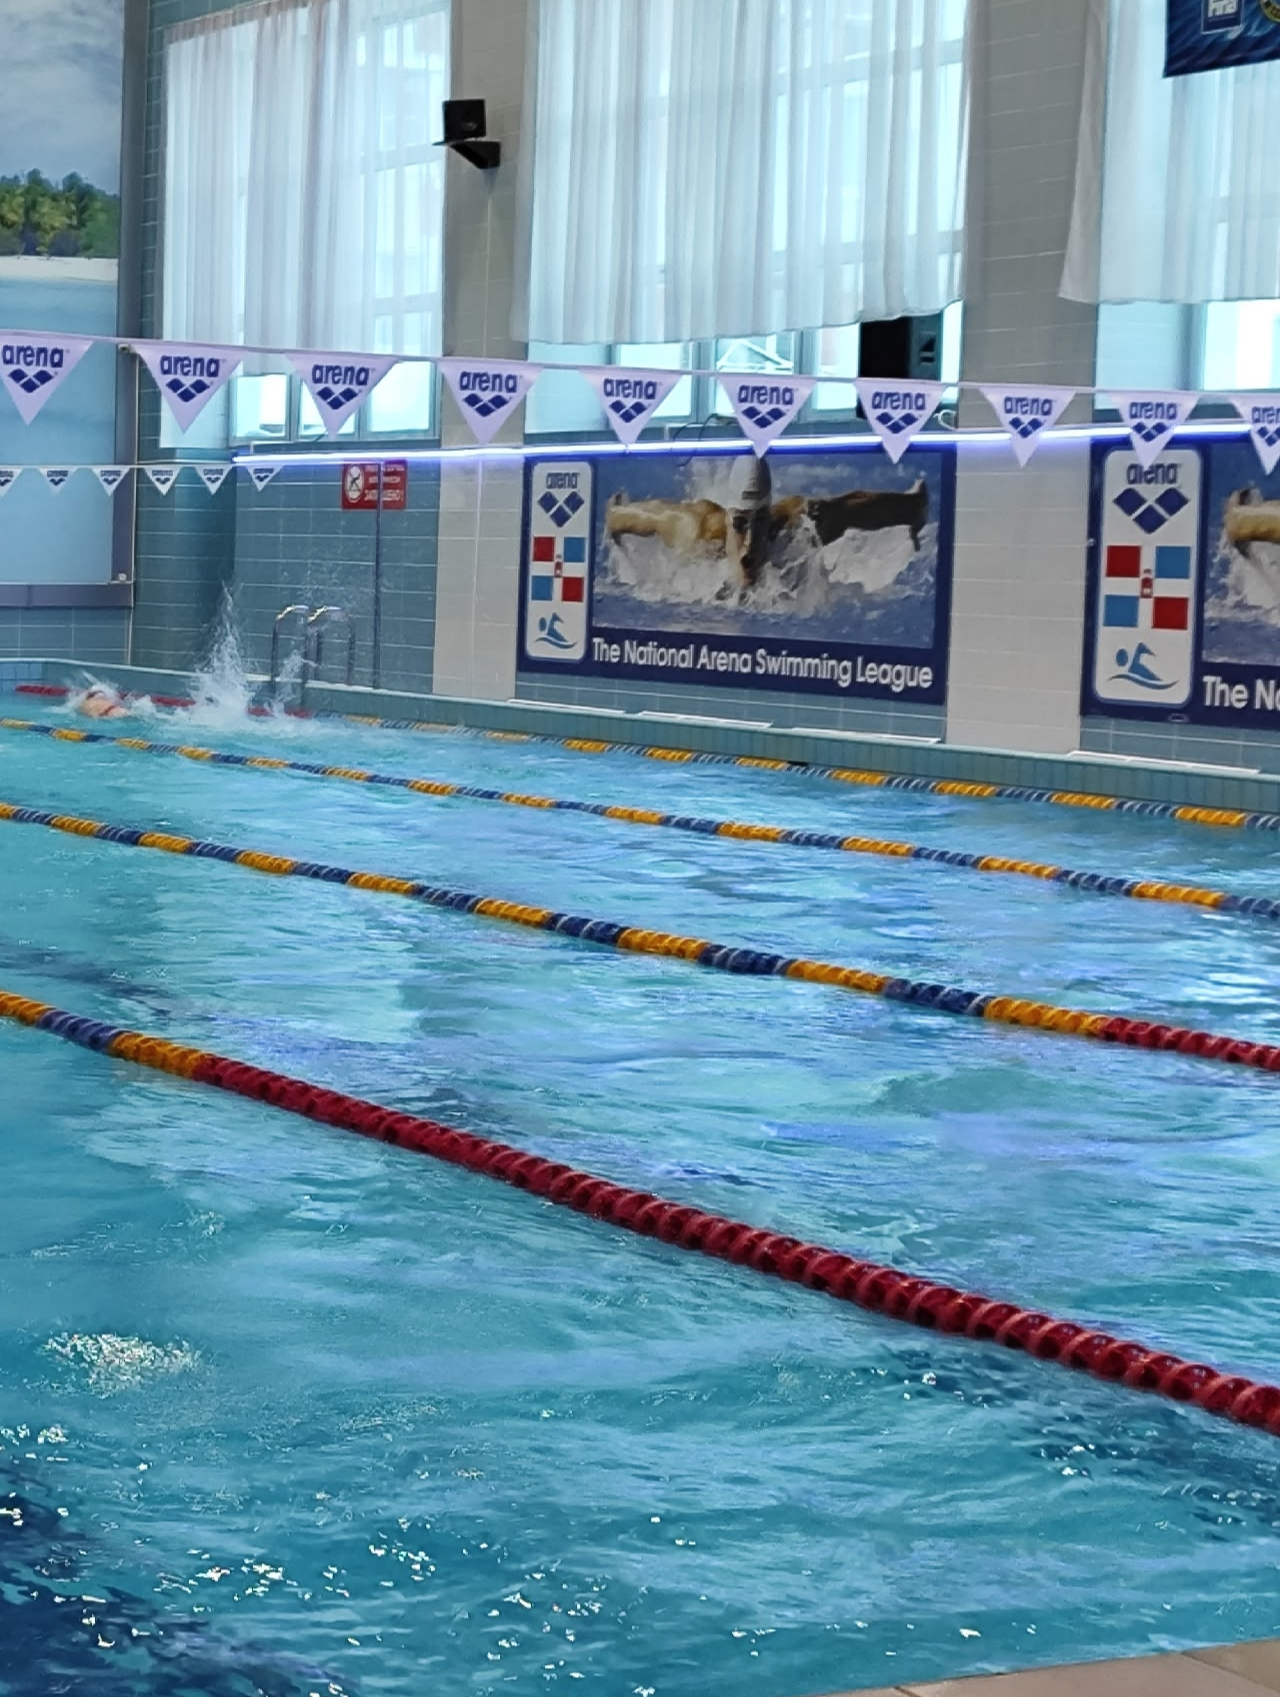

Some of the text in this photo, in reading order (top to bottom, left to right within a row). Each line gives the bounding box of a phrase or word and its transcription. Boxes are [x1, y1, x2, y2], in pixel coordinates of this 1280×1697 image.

[2, 344, 63, 367] arena
[160, 355, 219, 377] arena
[312, 364, 369, 386] arena
[460, 371, 517, 393] arena
[604, 379, 656, 400] arena
[737, 383, 794, 406] arena
[871, 391, 926, 411] arena
[1004, 396, 1052, 415] arena
[1129, 401, 1177, 420] arena
[1251, 406, 1280, 424] are
[592, 638, 933, 692] The National Arena Swimming League
[1202, 676, 1248, 708] The
